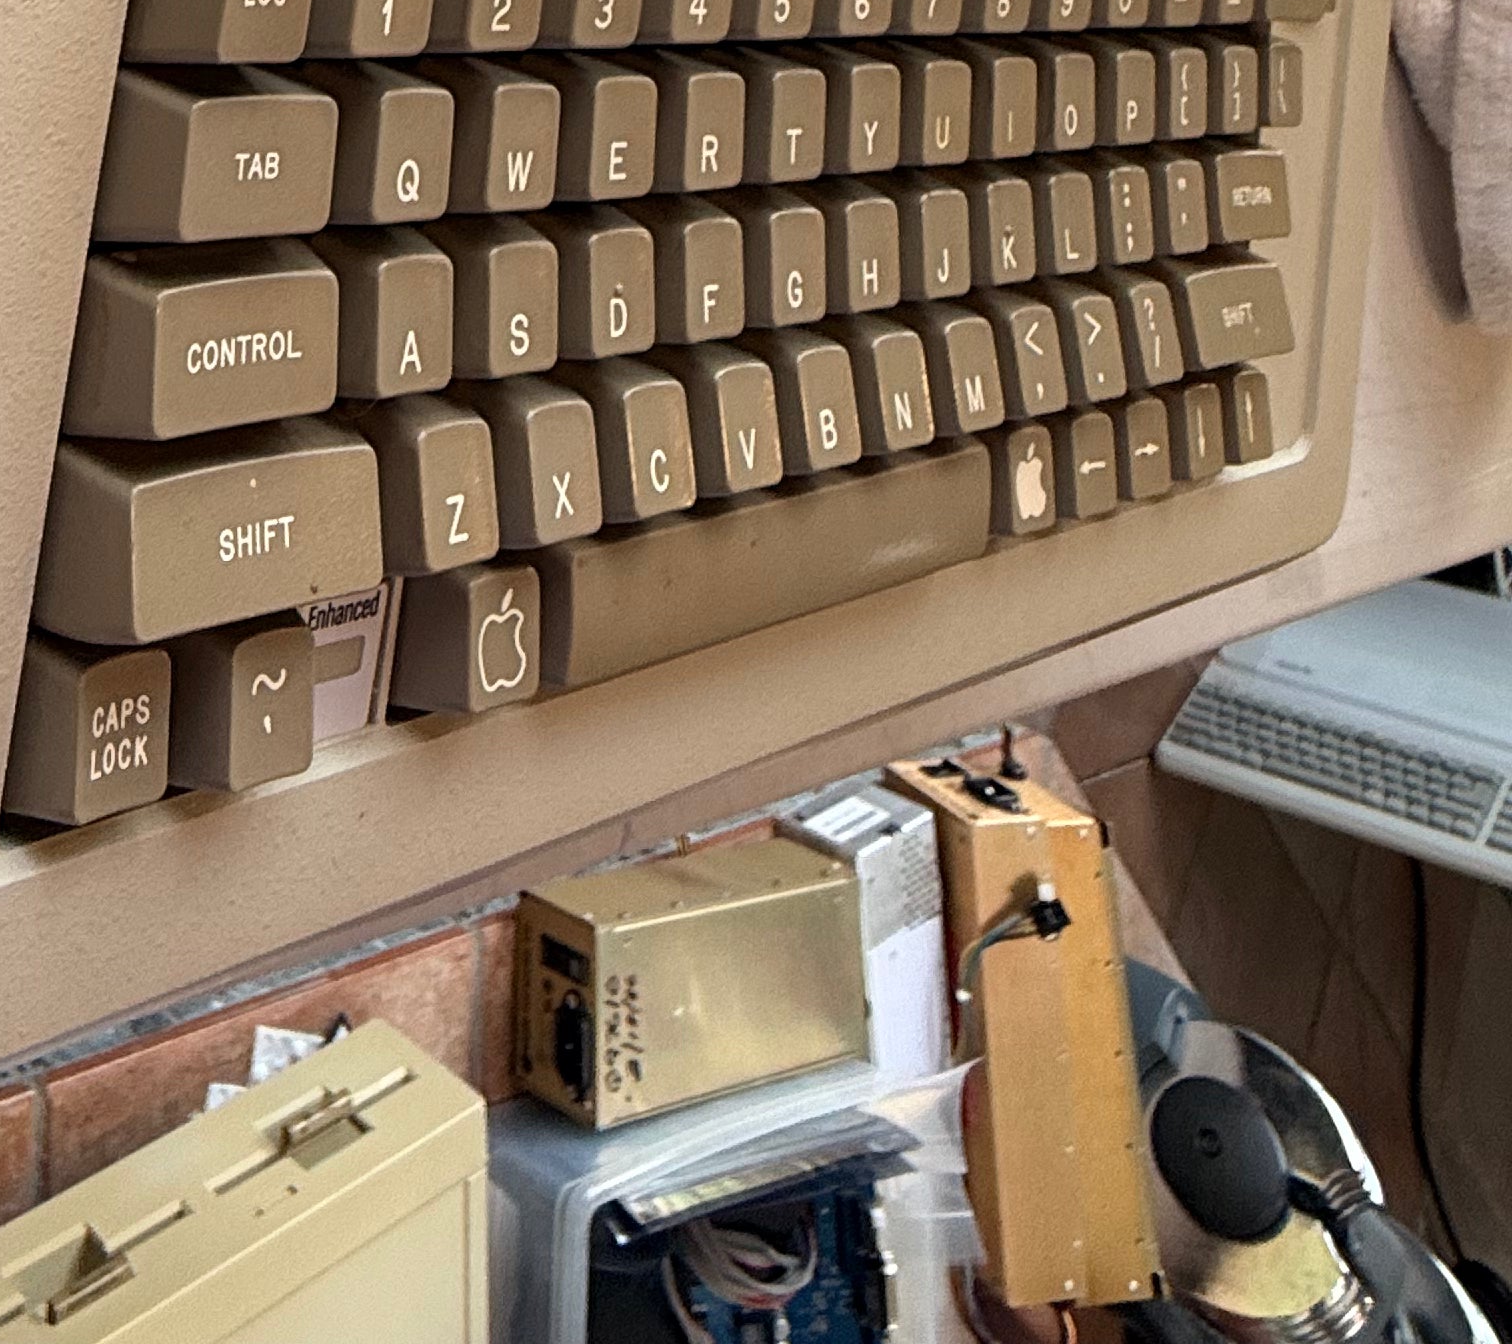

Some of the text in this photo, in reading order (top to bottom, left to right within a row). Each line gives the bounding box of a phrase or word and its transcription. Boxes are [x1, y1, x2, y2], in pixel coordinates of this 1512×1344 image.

[1064, 104, 1078, 137] O
[1126, 100, 1138, 131] P
[1180, 95, 1189, 126] [
[1232, 91, 1241, 121] ]
[863, 120, 879, 156] Y
[935, 115, 950, 150] U
[1008, 111, 1013, 142] I
[234, 151, 280, 181] TAB
[608, 141, 628, 181] E
[701, 134, 719, 173] R
[786, 128, 803, 165] T
[396, 158, 420, 203] Q
[507, 150, 534, 192] W
[1002, 235, 1017, 270] K
[1064, 229, 1080, 260] L
[862, 258, 878, 295] H
[937, 248, 949, 283] J
[703, 284, 720, 324] F
[786, 270, 803, 309] G
[609, 297, 628, 338] D
[1084, 312, 1102, 345] >
[1143, 298, 1156, 331] ?
[187, 329, 303, 374] CONTROL
[399, 330, 422, 375] A
[509, 313, 530, 356] S
[1024, 321, 1044, 356] <
[894, 391, 913, 431] N
[965, 375, 986, 413] M
[738, 427, 756, 470] V
[819, 408, 838, 450] B
[650, 448, 670, 493] C
[552, 471, 574, 519] X
[219, 515, 295, 562] SHIFT
[445, 493, 470, 545] Z
[308, 590, 381, 631] Enhanced
[251, 668, 286, 696] ~
[92, 694, 150, 738] CAPS
[90, 731, 148, 781] LOCK
